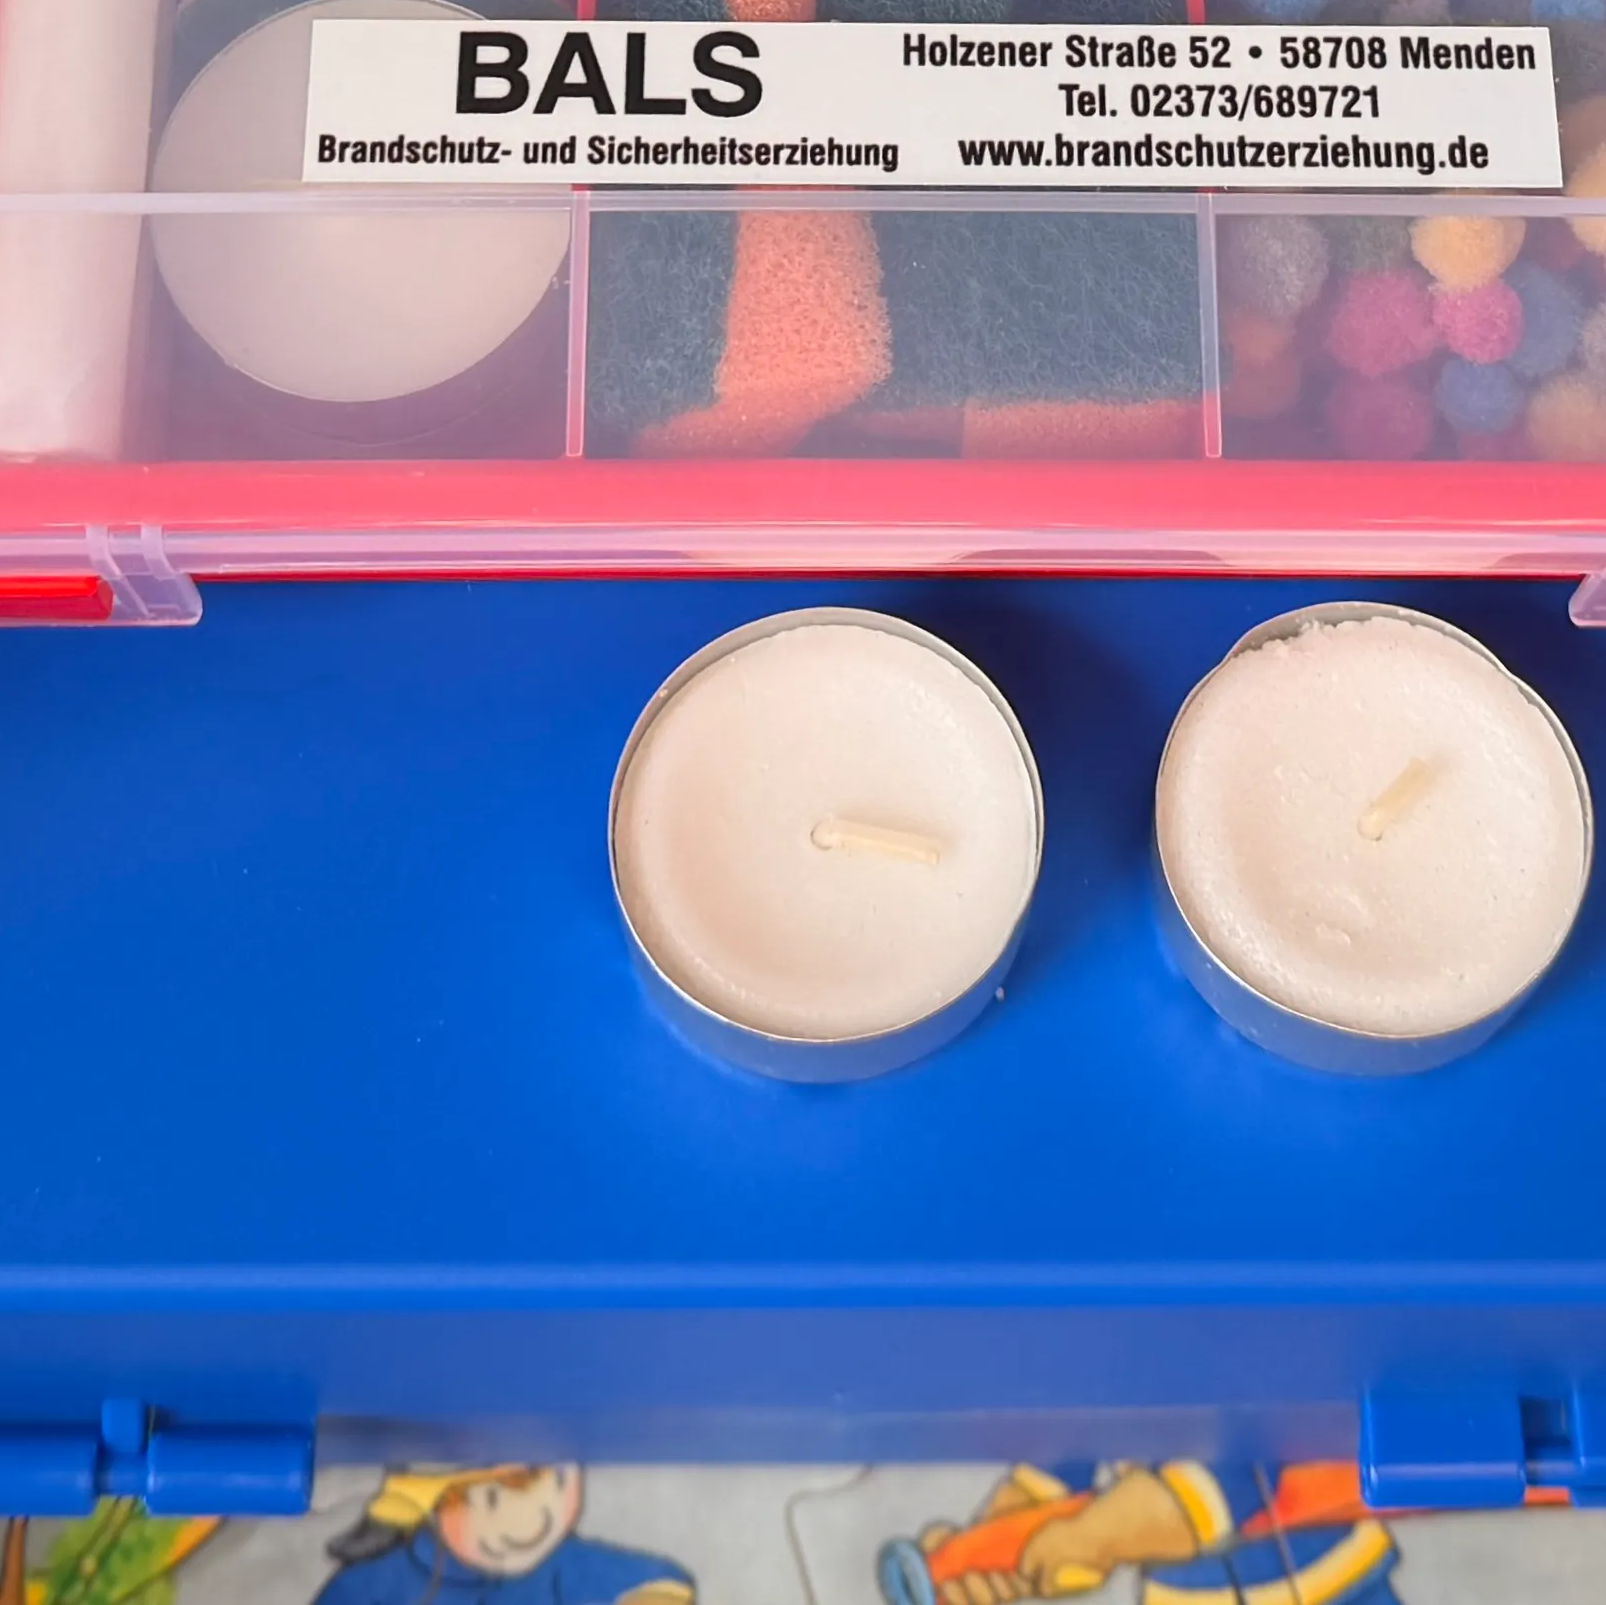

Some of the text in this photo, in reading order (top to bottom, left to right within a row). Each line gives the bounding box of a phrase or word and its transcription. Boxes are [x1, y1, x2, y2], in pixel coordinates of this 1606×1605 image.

[904, 34, 1535, 69] Holzener Straße 52 58708 Menden
[456, 31, 762, 117] BALS
[1058, 84, 1379, 121] Tel. 02373/689721
[319, 135, 898, 172] Brandschutz- und Sicherheitserziehung
[958, 133, 1488, 175] www.brandschutzerziehung.de
